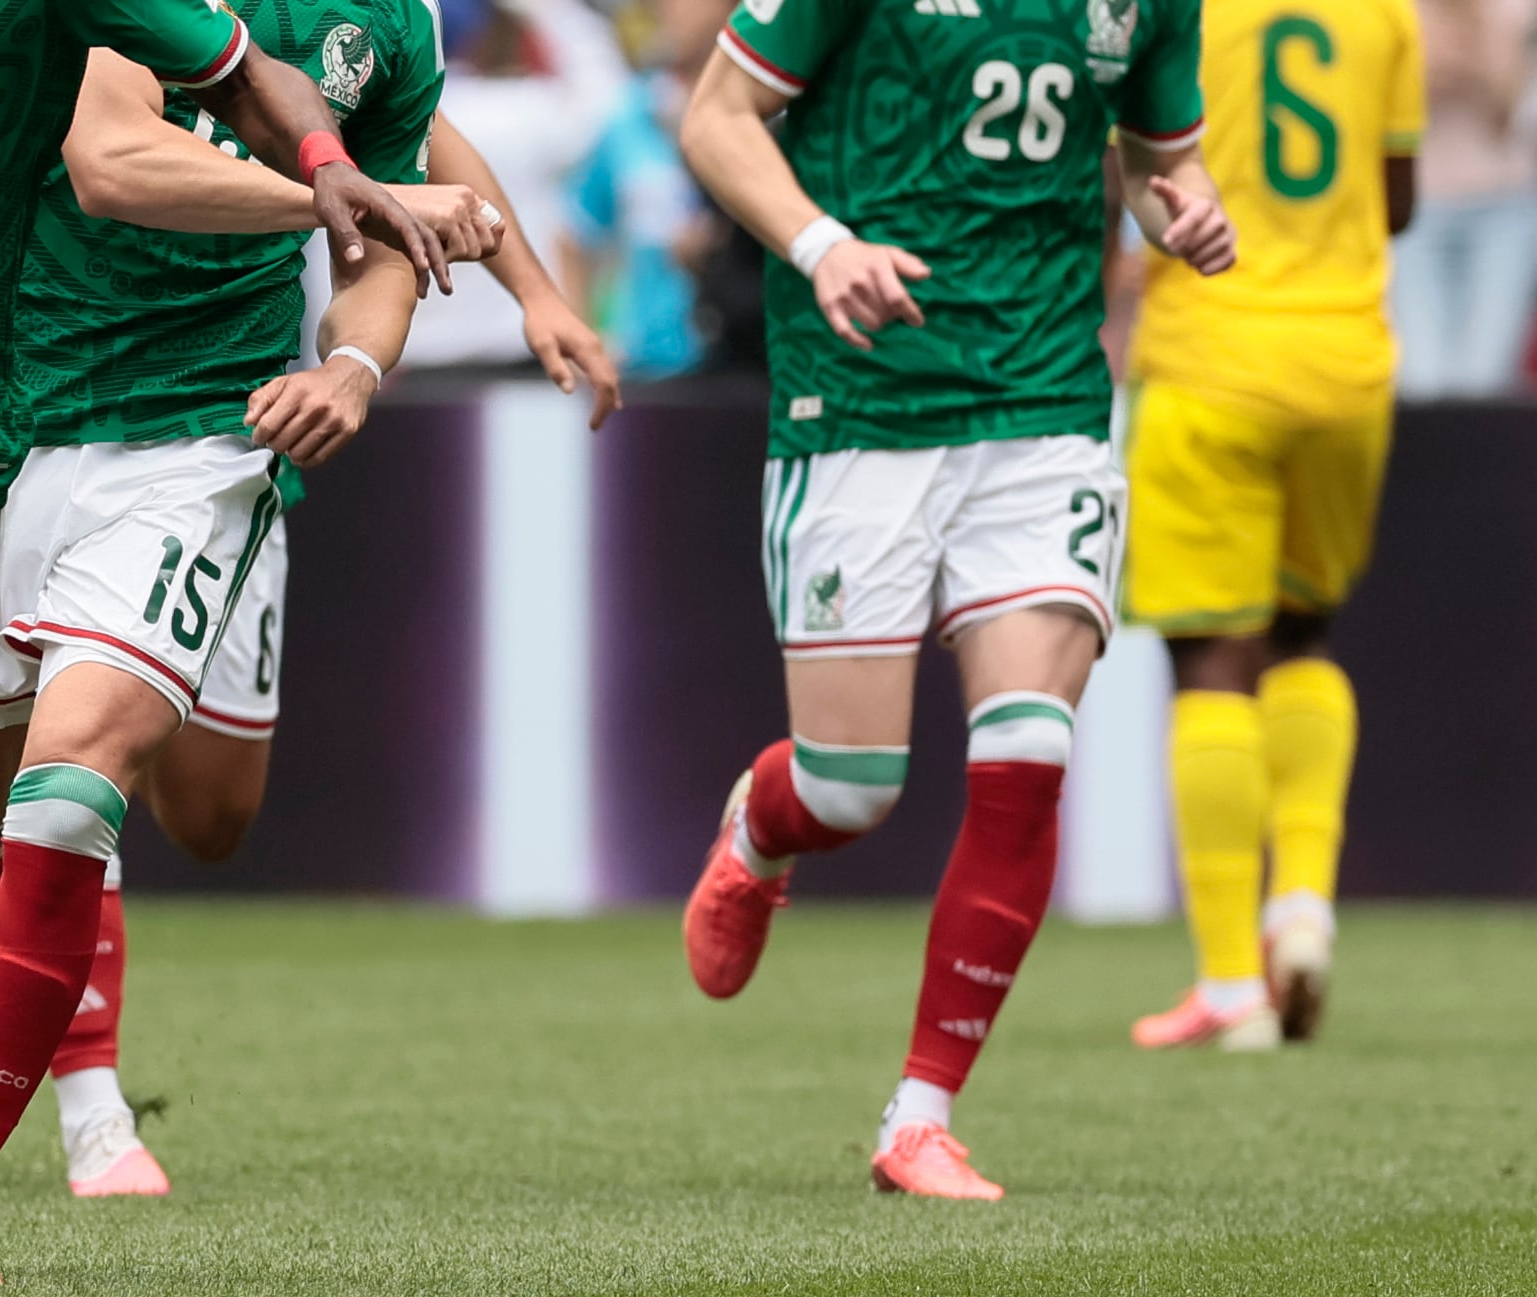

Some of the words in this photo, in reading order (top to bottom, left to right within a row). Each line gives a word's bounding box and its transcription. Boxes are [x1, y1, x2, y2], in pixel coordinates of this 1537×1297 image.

[320, 82, 359, 108] MÉXICO
[962, 59, 1074, 163] 26
[1261, 15, 1338, 200] 6
[142, 534, 222, 652] 15
[256, 602, 277, 696] 6
